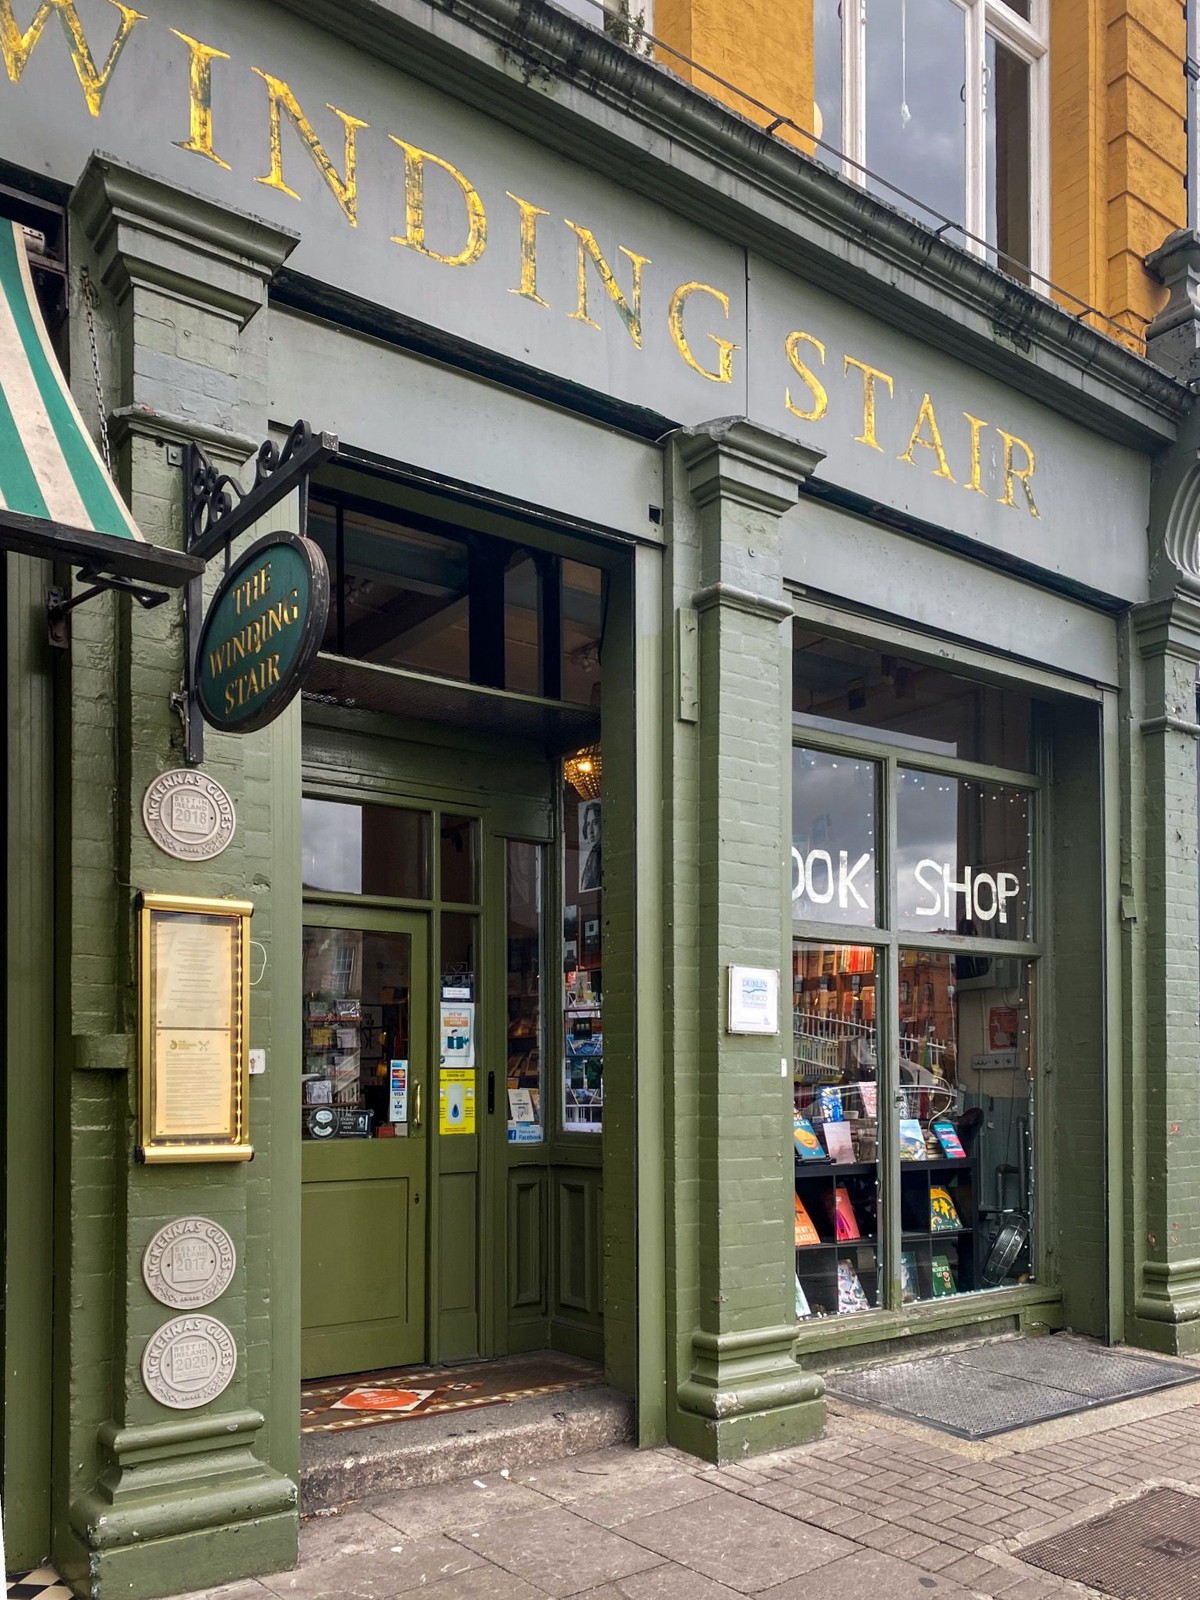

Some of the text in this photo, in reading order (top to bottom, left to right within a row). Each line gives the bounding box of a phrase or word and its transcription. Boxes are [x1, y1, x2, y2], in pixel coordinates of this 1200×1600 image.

[0, 0, 1042, 519] WINDING STAIR
[232, 561, 272, 615] THE
[208, 587, 299, 679] WINDING
[224, 652, 281, 714] STAIR
[174, 796, 195, 804] BEST
[174, 803, 207, 811] IRELAND
[175, 809, 207, 824] 2018
[206, 783, 232, 830] GUIDES
[913, 859, 1020, 924] SHOP
[742, 978, 768, 988] DUBLIN
[176, 1258, 207, 1272] 2017
[206, 1226, 231, 1271] GUIDES
[175, 1355, 208, 1371] 2020
[206, 1323, 232, 1366] GUIDES
